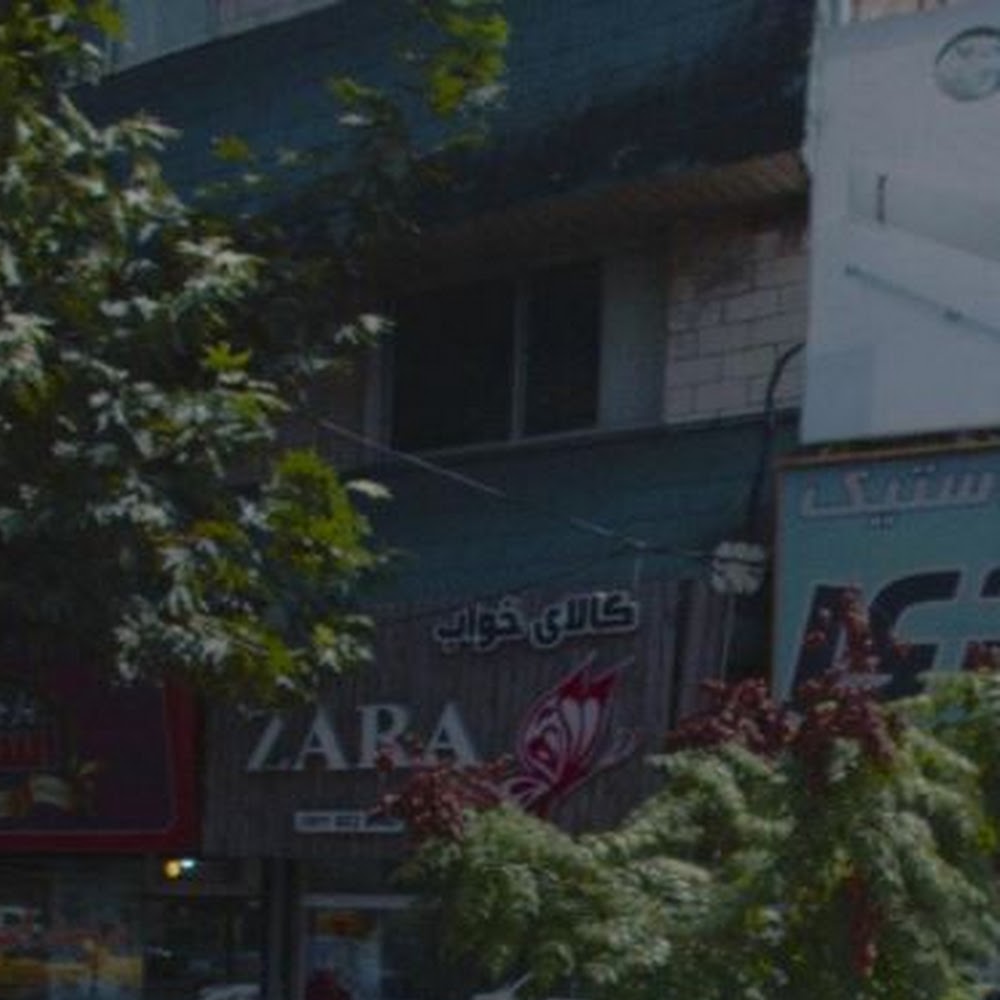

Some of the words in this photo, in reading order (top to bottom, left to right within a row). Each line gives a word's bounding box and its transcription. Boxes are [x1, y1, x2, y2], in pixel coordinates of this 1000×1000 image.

[432, 594, 529, 656] خواب
[530, 591, 640, 650] کالای
[246, 701, 482, 773] ZARA
